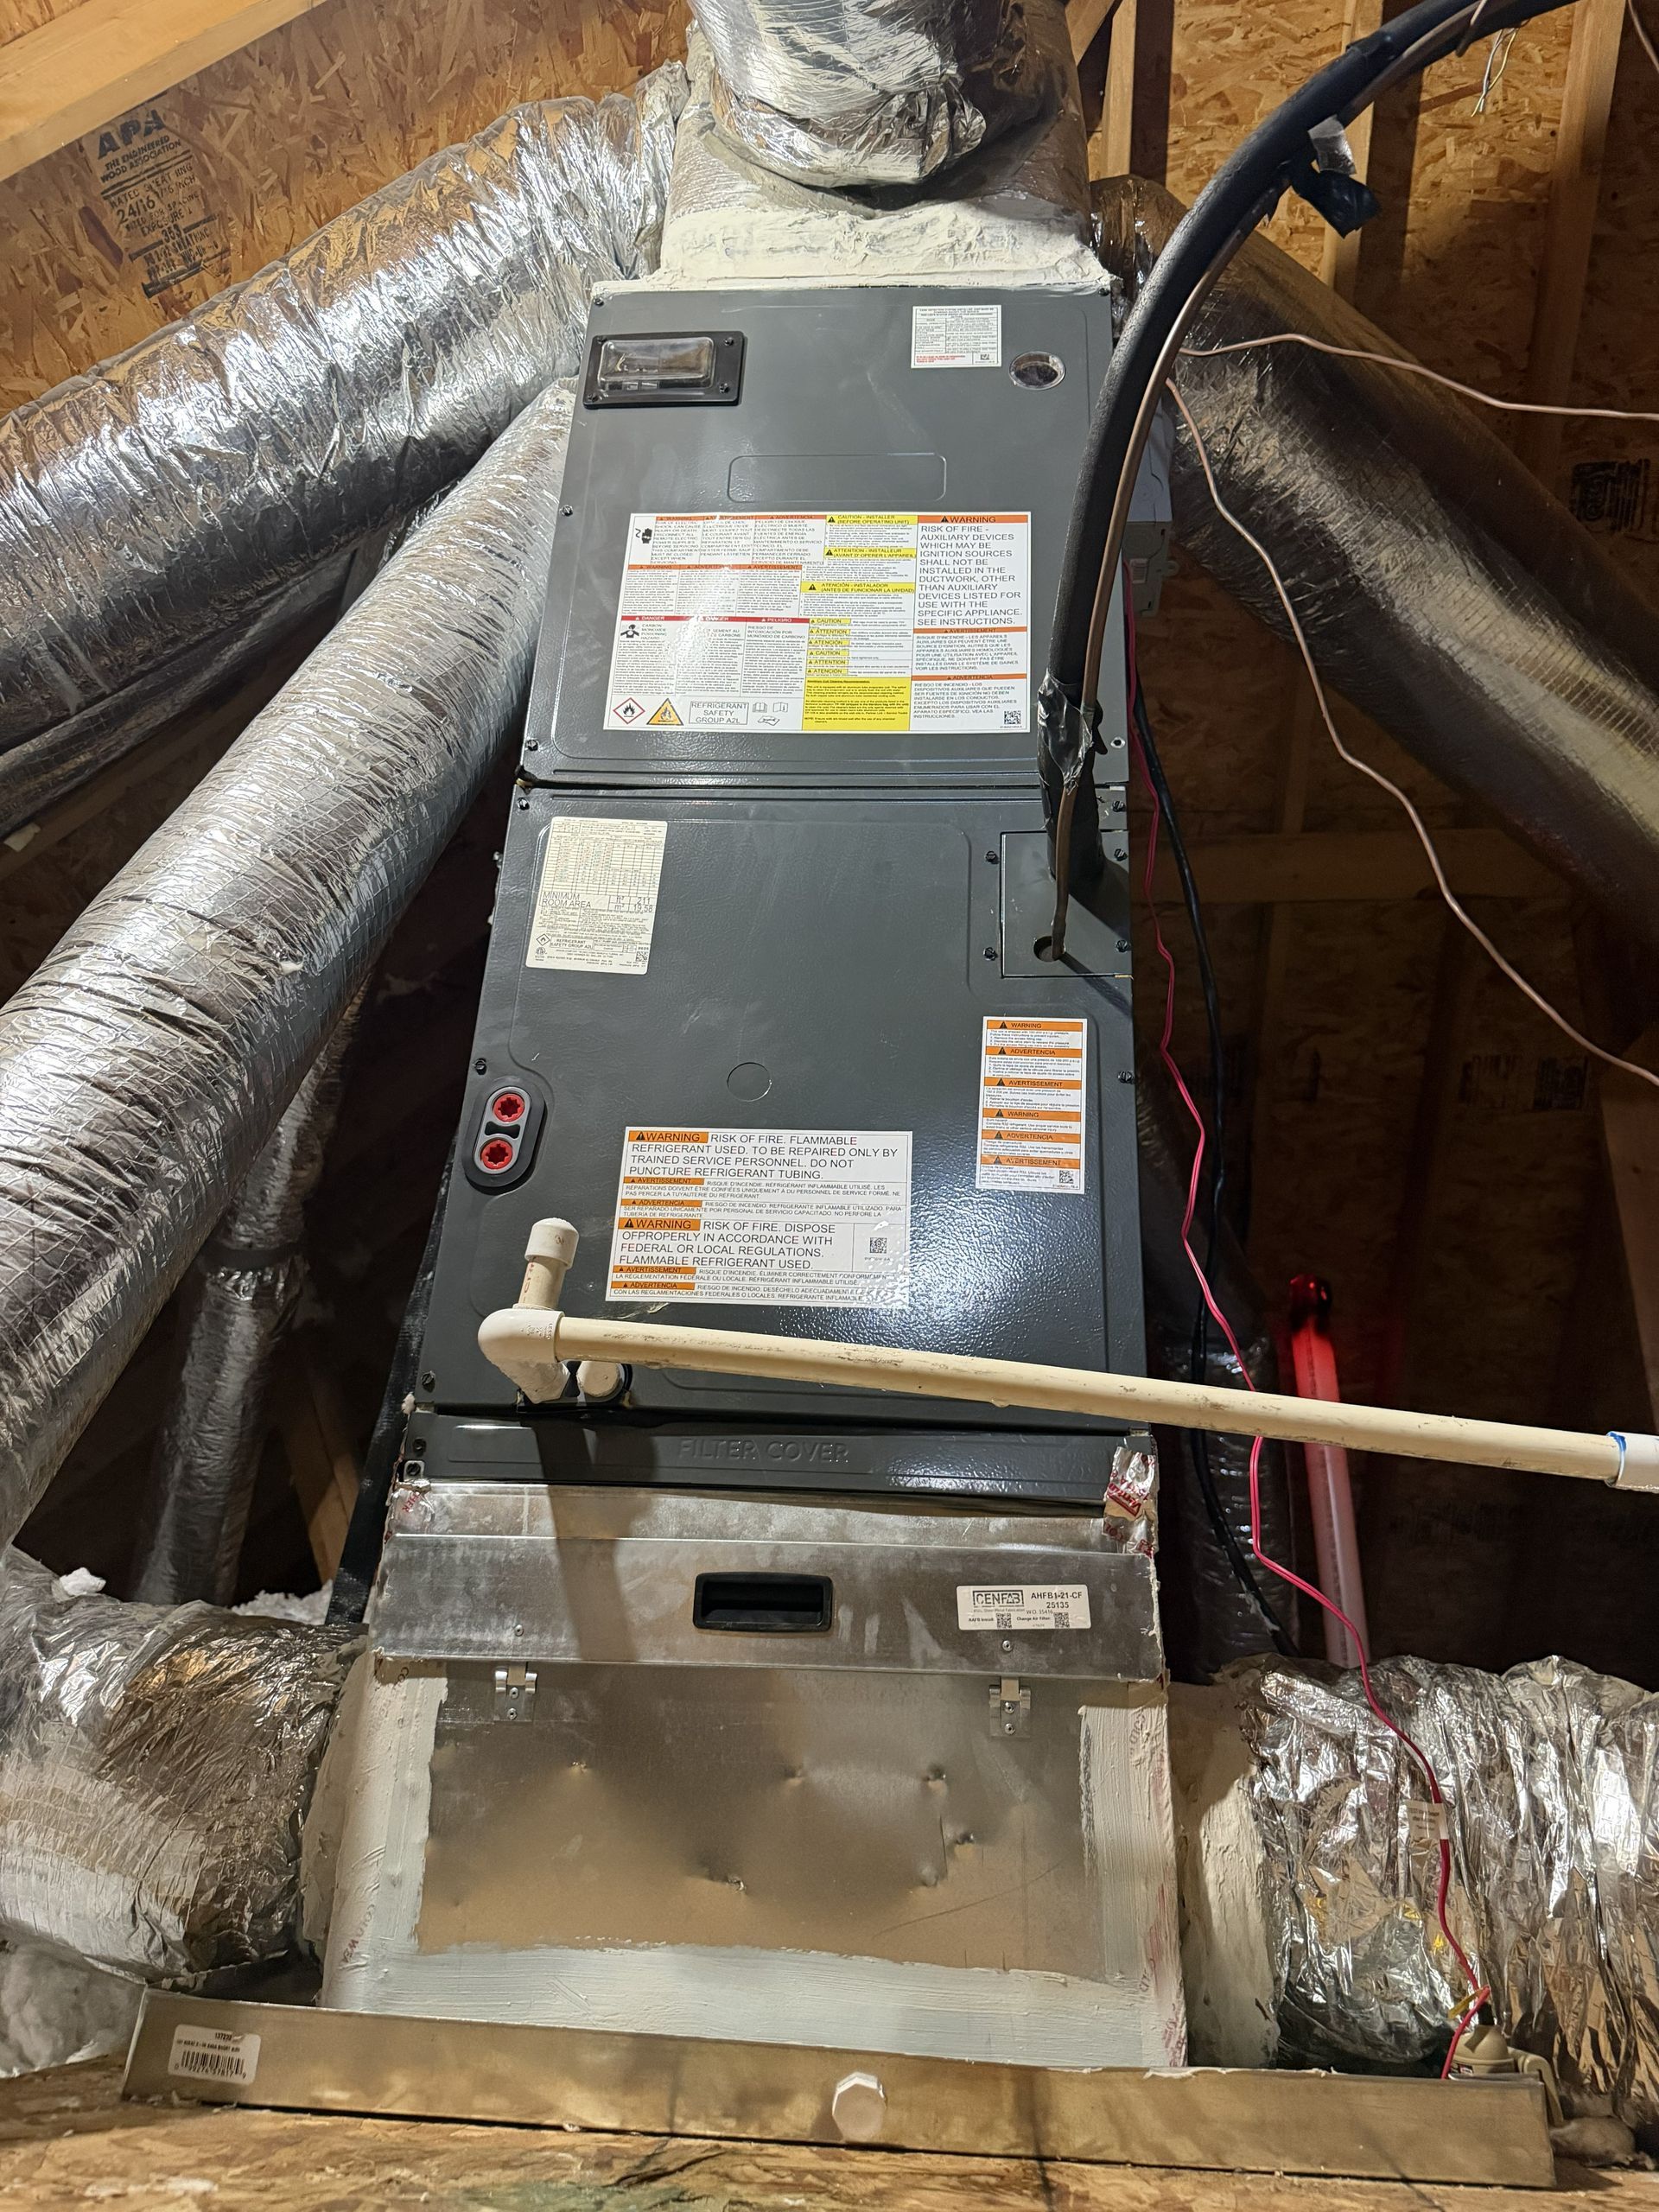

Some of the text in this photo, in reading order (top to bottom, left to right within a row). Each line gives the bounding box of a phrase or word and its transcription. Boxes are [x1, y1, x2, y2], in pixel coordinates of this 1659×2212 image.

[98, 110, 166, 160] APA
[100, 140, 181, 183] WOOD ASSOCIATION
[105, 159, 119, 170] THE
[711, 1135, 736, 1143] RISK
[741, 1135, 755, 1143] OF
[759, 1135, 785, 1144] FIRE.
[791, 1136, 857, 1145] FLAMMABLE
[632, 1144, 711, 1154] REFRIGERANT
[715, 1146, 747, 1154] USED.
[789, 1147, 845, 1156] REPAIRED
[849, 1148, 880, 1157] ONLY
[632, 1155, 679, 1164] TRAINED
[683, 1156, 731, 1166] SERVICE
[735, 1158, 806, 1167] PERSONNEL.
[695, 1168, 774, 1178] REFRIGERANT
[779, 1169, 823, 1179] TUBING.
[637, 1220, 836, 1233] WARNING RISK OF FIRE. DISPOSE
[622, 1231, 700, 1241] OFPROPERLY
[718, 1234, 798, 1244] ACCORDANCE
[804, 1236, 833, 1245] WITH
[621, 1243, 823, 1257] FEDERAL OR LOCAL REGULATIONS.
[620, 1255, 813, 1269] FLAMMABLE REFRIGERANT USED.
[679, 1439, 849, 1462] FILTER COVER
[976, 1593, 1020, 1605] CENFAB
